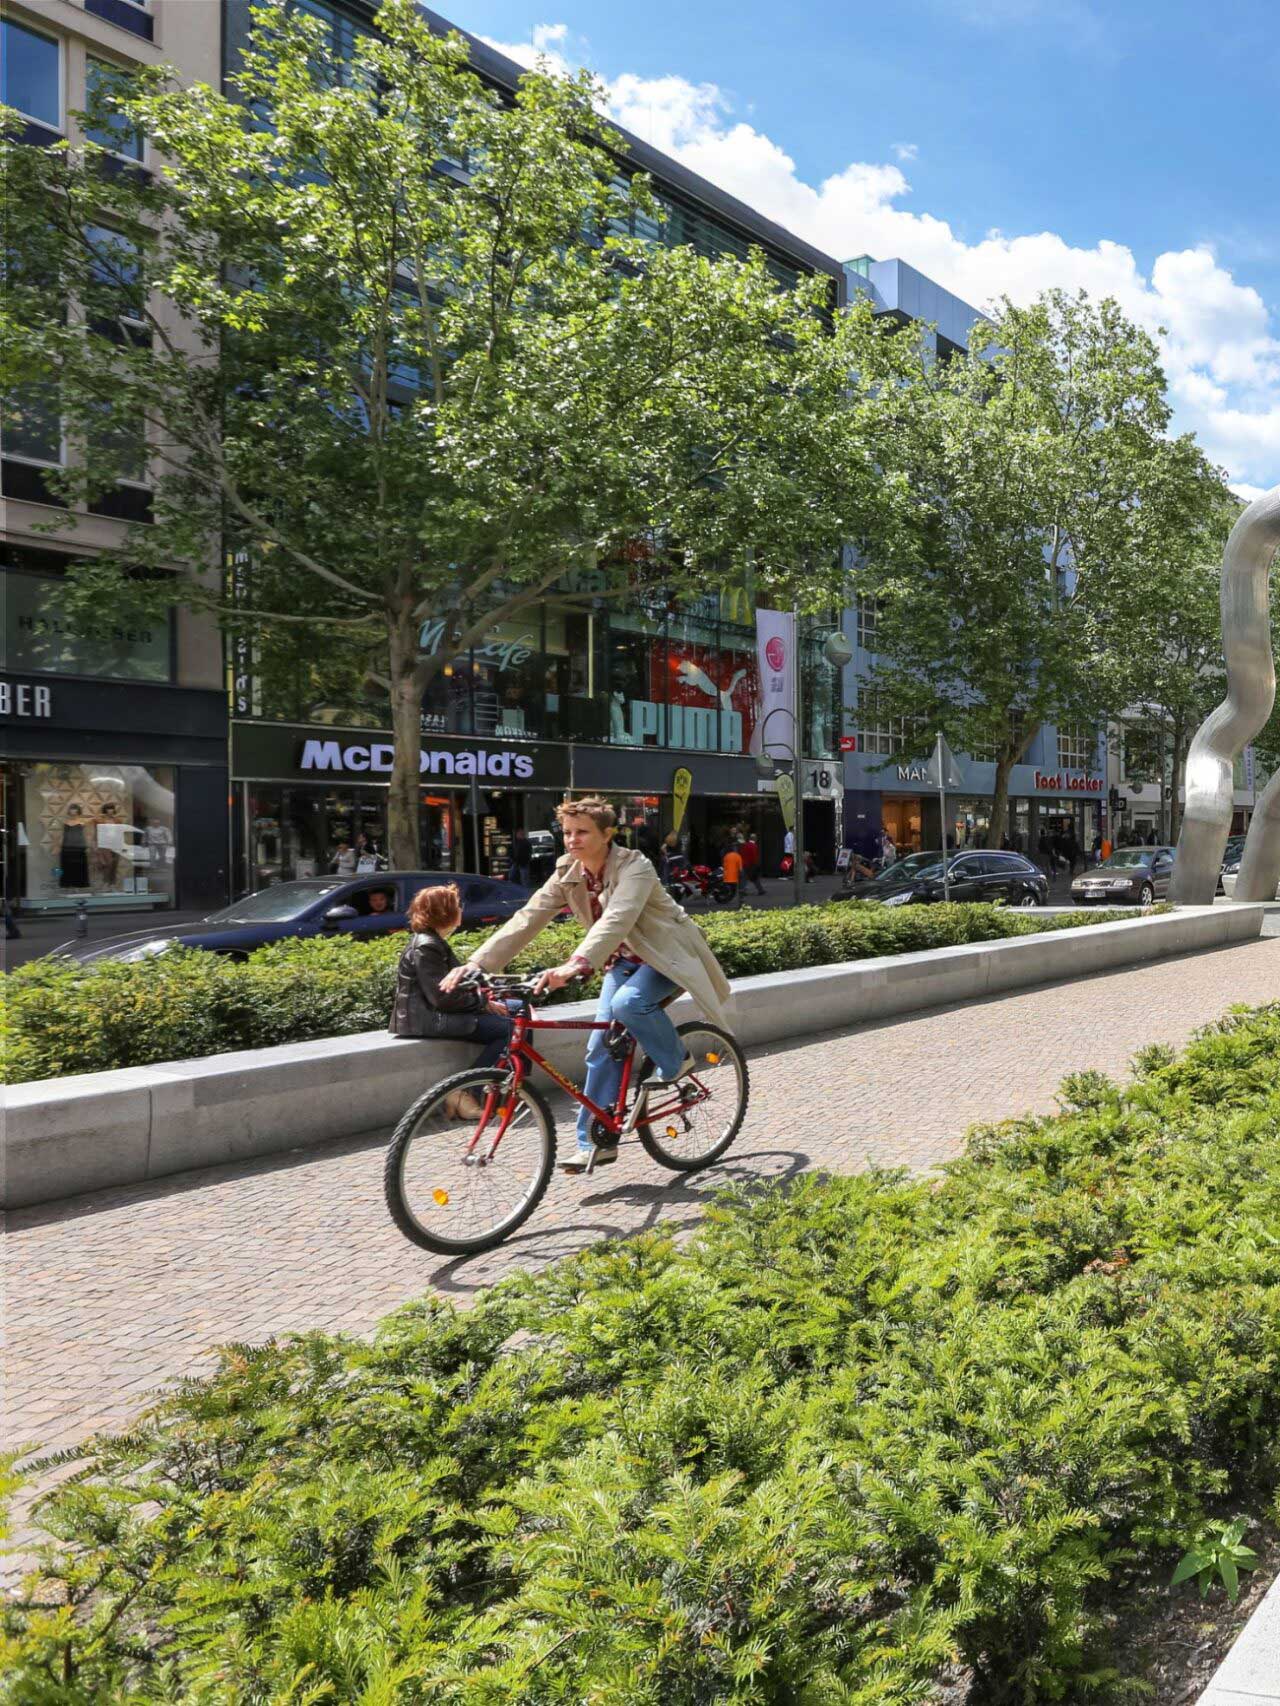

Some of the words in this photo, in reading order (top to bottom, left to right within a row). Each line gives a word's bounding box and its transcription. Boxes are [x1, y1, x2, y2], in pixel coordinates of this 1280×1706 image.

[0, 682, 51, 718] BER
[630, 699, 743, 754] PUMA
[810, 770, 830, 788] 18
[897, 765, 930, 781] MAN
[1034, 769, 1062, 791] Foot
[1065, 770, 1104, 791] Locker
